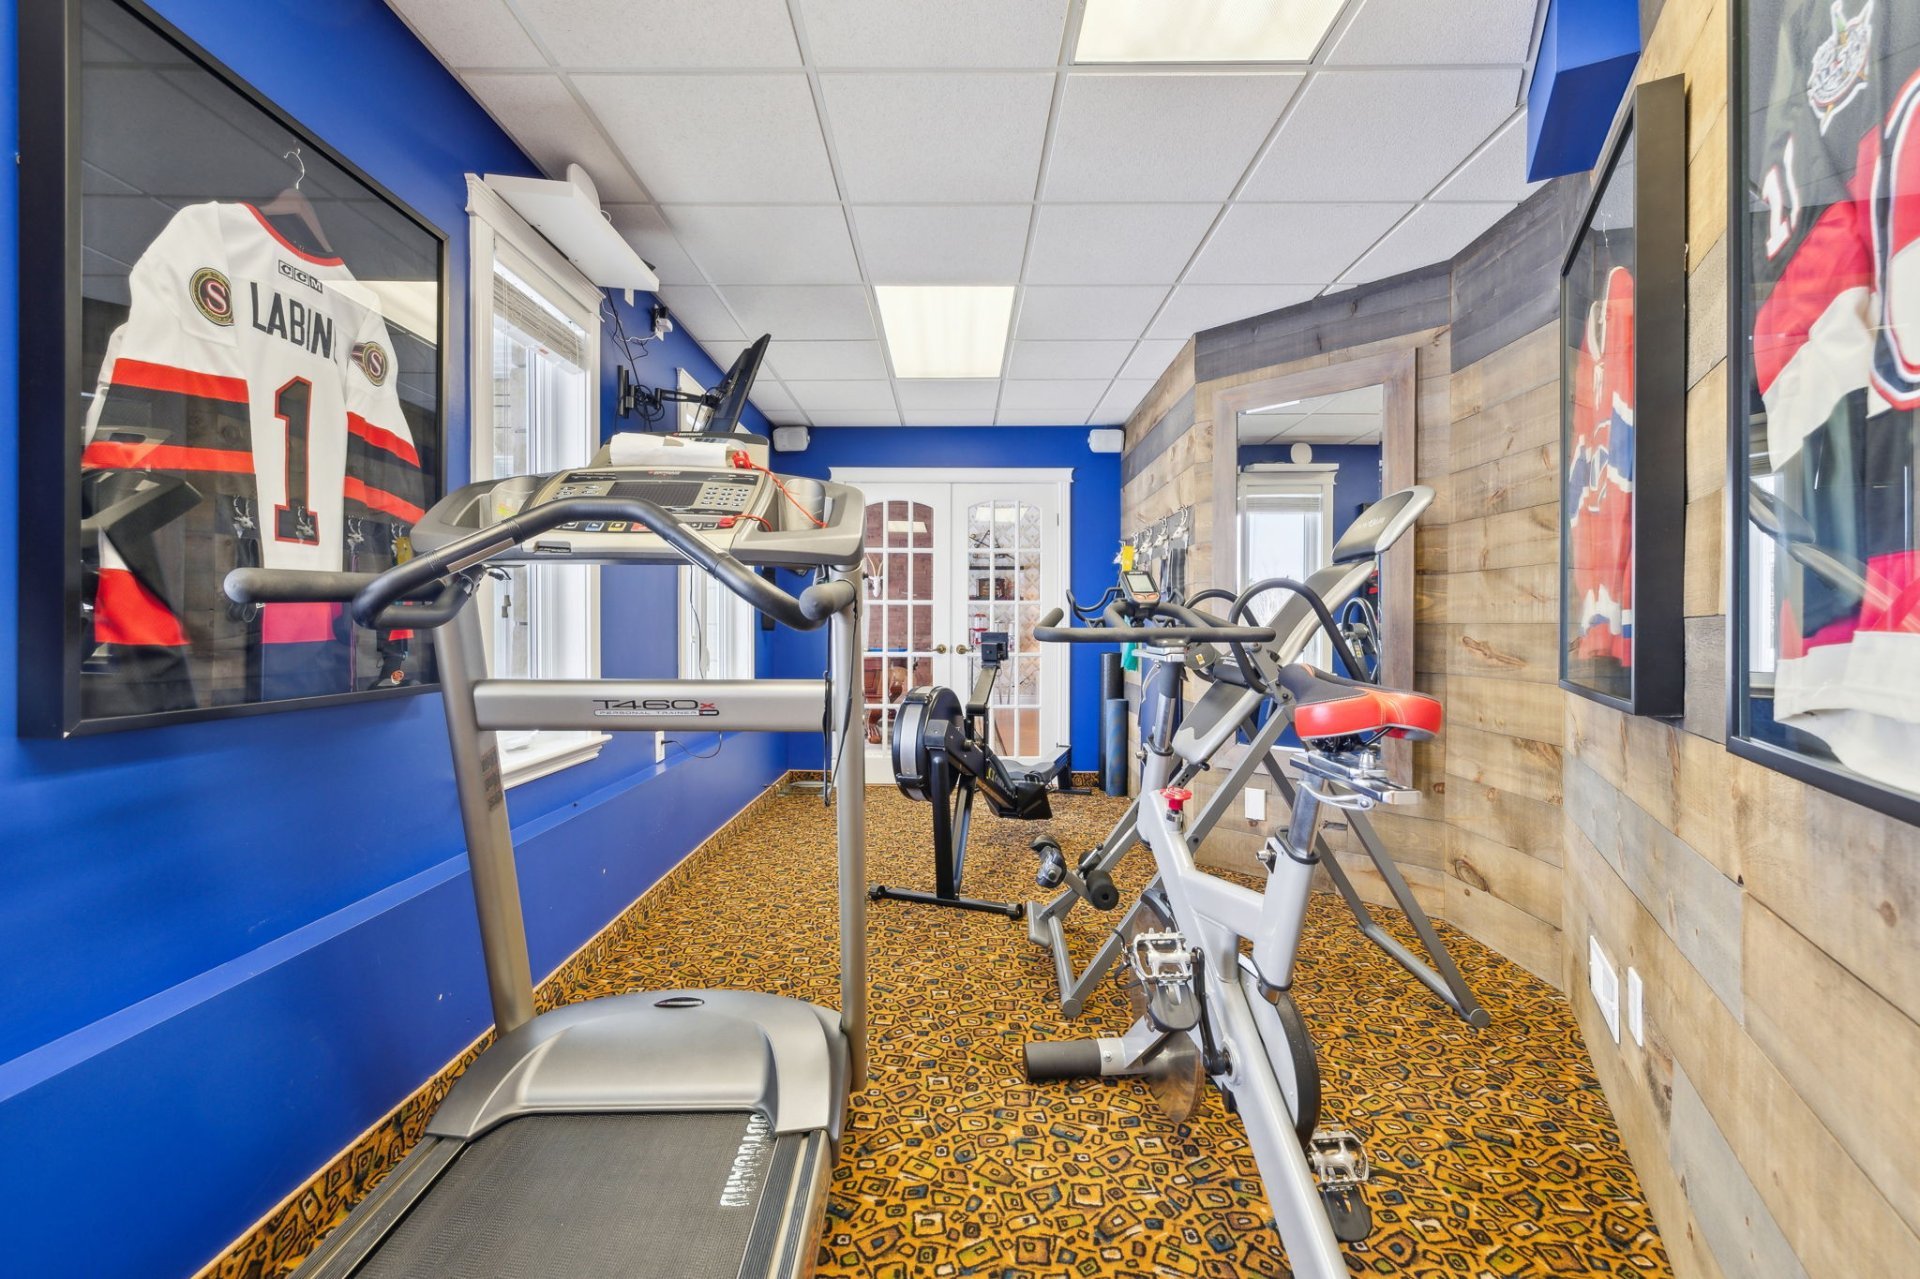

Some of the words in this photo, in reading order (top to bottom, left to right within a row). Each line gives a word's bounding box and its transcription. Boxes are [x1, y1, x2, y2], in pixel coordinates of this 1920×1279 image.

[279, 260, 323, 294] CCM
[250, 281, 338, 365] LABIN
[274, 375, 320, 546] 1
